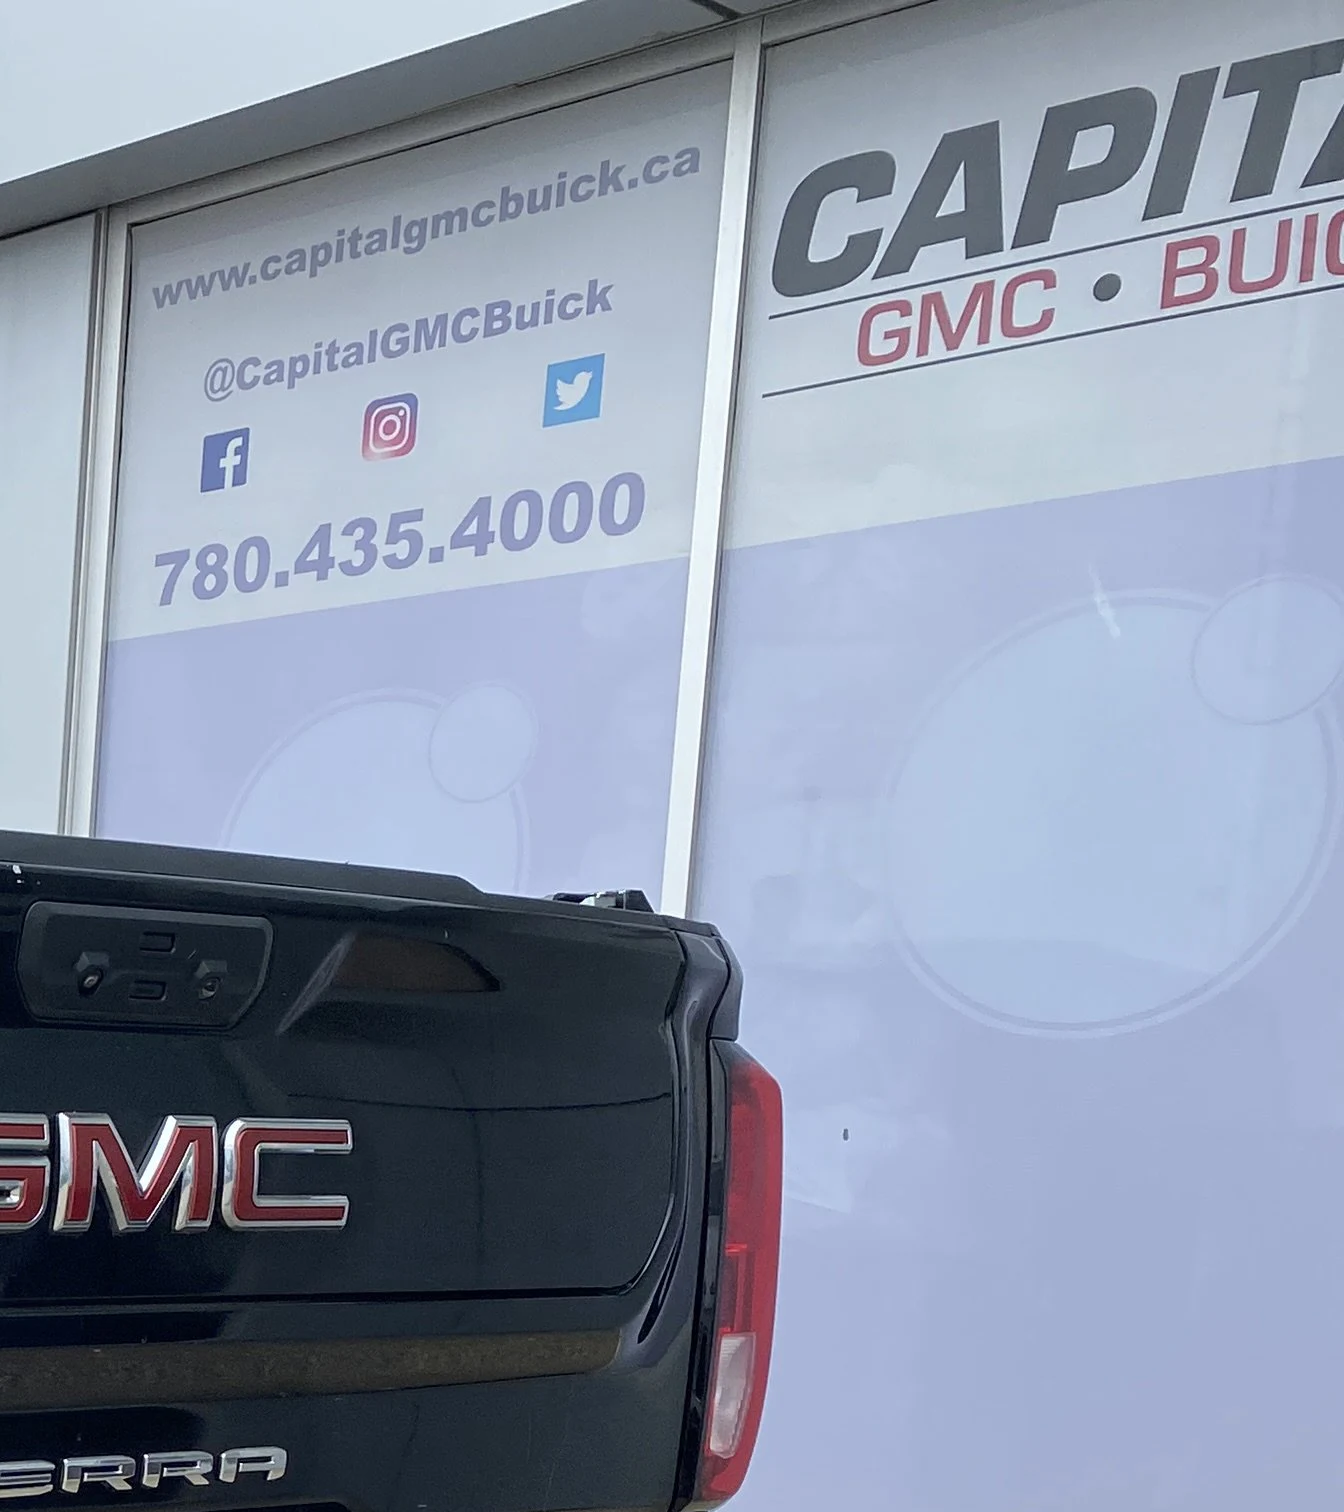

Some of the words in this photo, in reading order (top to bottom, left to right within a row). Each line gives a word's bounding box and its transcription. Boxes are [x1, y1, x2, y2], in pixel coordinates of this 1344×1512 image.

[152, 146, 701, 309] www.capitalgmcbuick.ca
[204, 278, 614, 402] @CapitalGMCBuick
[857, 268, 1057, 367] GMC
[154, 472, 645, 607] 780.435.4000
